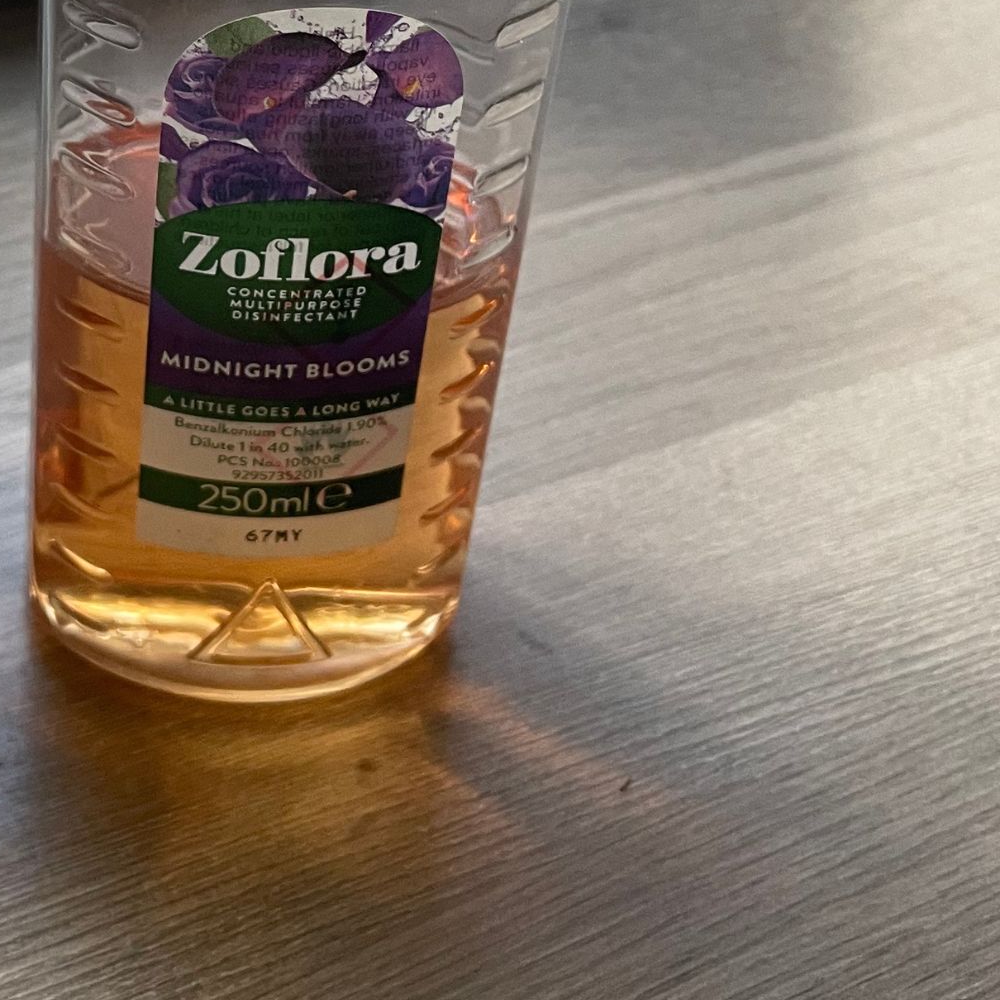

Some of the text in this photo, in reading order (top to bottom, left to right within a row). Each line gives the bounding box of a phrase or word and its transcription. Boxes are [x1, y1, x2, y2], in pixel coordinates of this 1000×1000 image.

[178, 231, 421, 282] Zoflora
[227, 286, 367, 299] CONCENTRATED
[230, 298, 361, 310] MULTIPURPOSE
[232, 309, 358, 322] DISINFECTANT
[161, 350, 411, 379] MIDNIGHT BLOOMS
[163, 392, 400, 417] A LITTLE GOES A LONG WAY
[174, 416, 277, 437] Benzalkonium
[281, 421, 342, 438] Chloride
[190, 434, 236, 451] Dilute
[249, 441, 263, 453] in
[267, 442, 289, 453] 40
[294, 440, 324, 453] with
[217, 454, 248, 467] PCS
[198, 482, 309, 513] 250ml
[245, 529, 304, 542] 67MY
